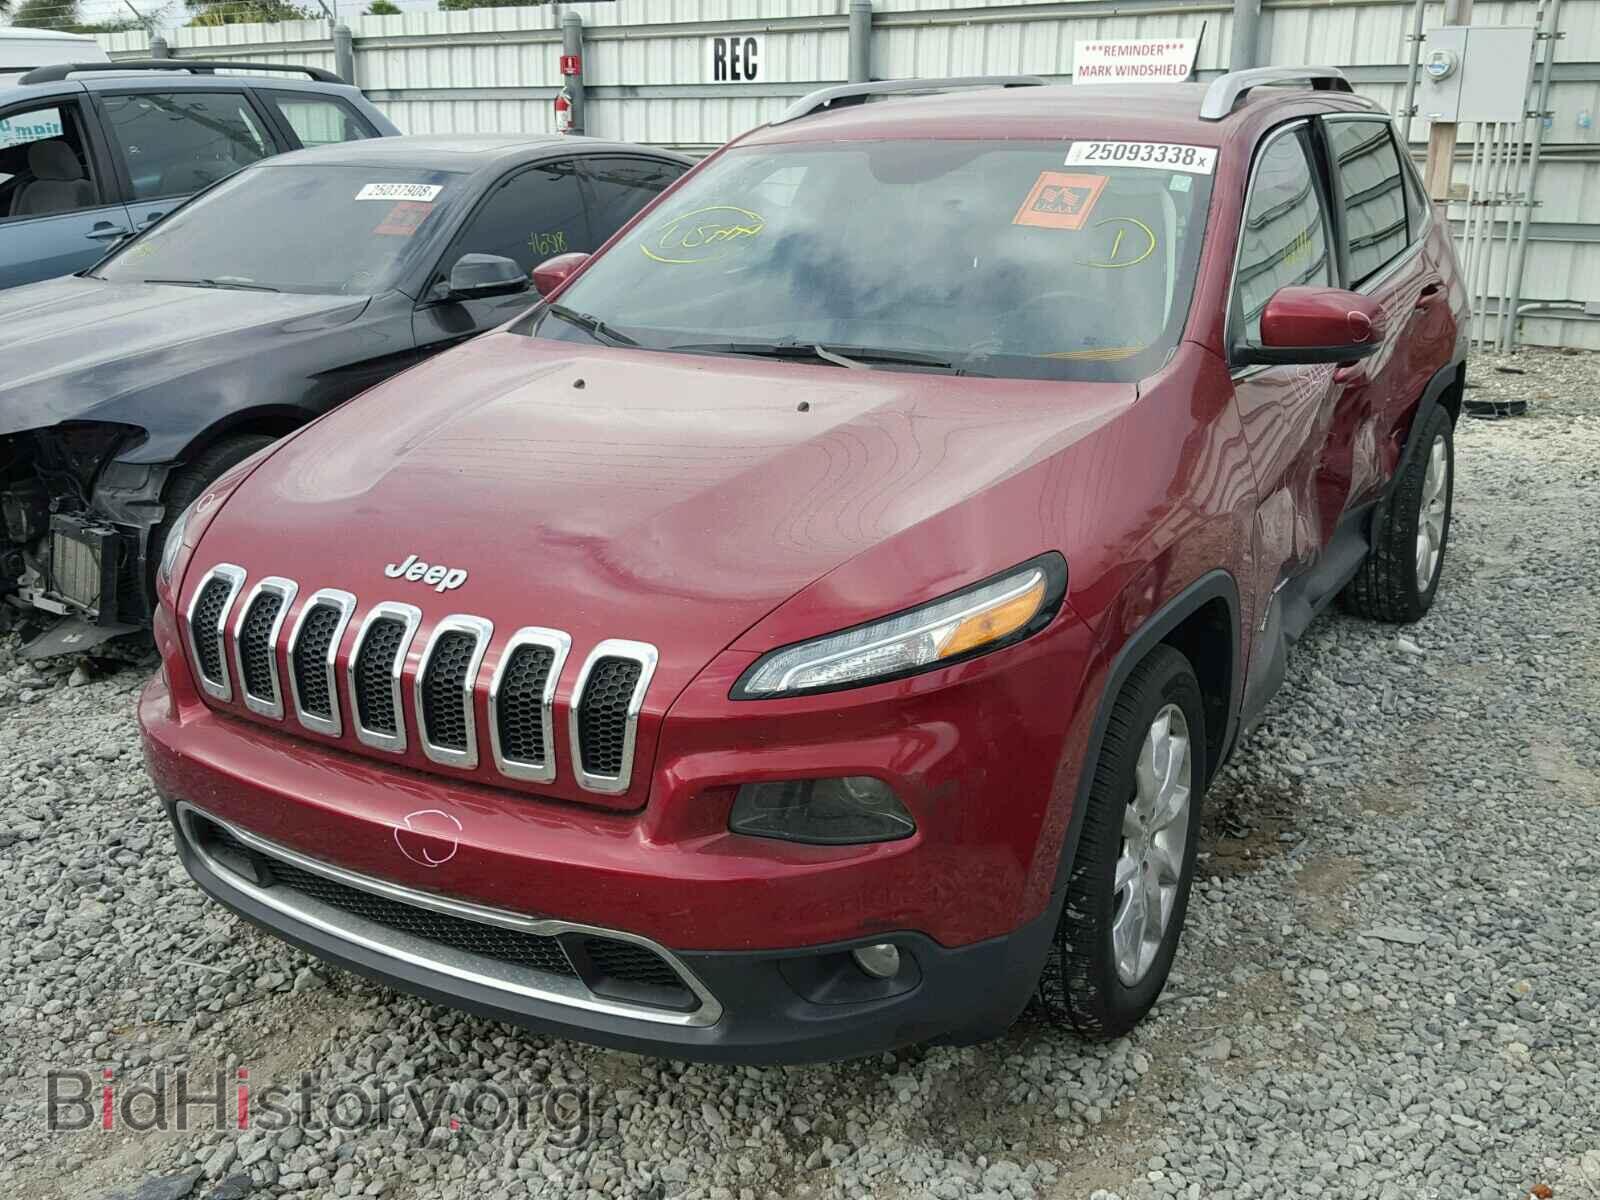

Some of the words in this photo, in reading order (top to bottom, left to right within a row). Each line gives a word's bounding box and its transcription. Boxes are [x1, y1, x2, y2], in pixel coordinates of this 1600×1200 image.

[713, 37, 758, 81] REC
[1078, 65, 1112, 77] MARK
[1115, 63, 1188, 77] WINDSHIELD
[384, 554, 468, 594] Jeep
